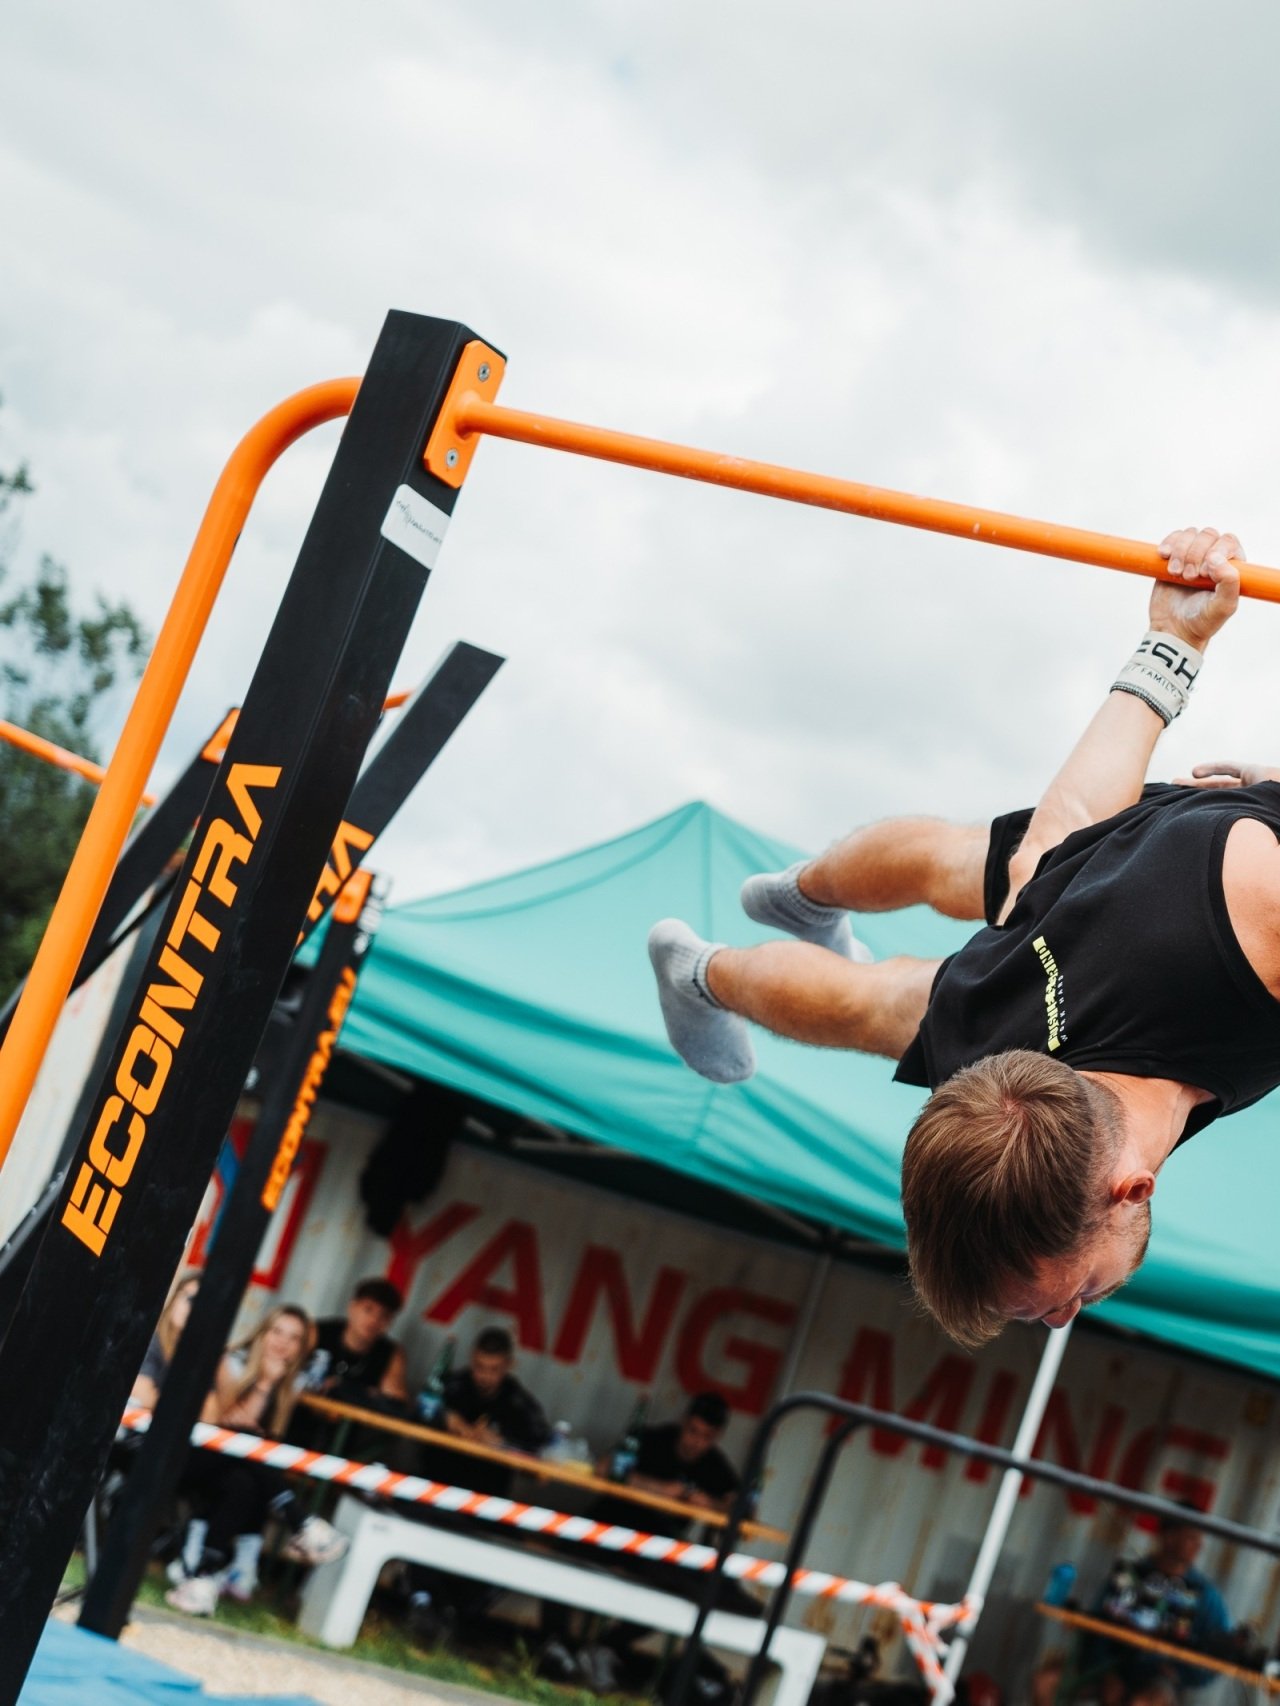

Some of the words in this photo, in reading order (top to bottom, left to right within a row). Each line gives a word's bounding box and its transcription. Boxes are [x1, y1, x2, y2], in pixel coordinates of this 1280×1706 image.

[62, 764, 281, 1256] ECONTRA
[384, 1202, 800, 1418] YANG
[823, 1325, 1231, 1537] MING
